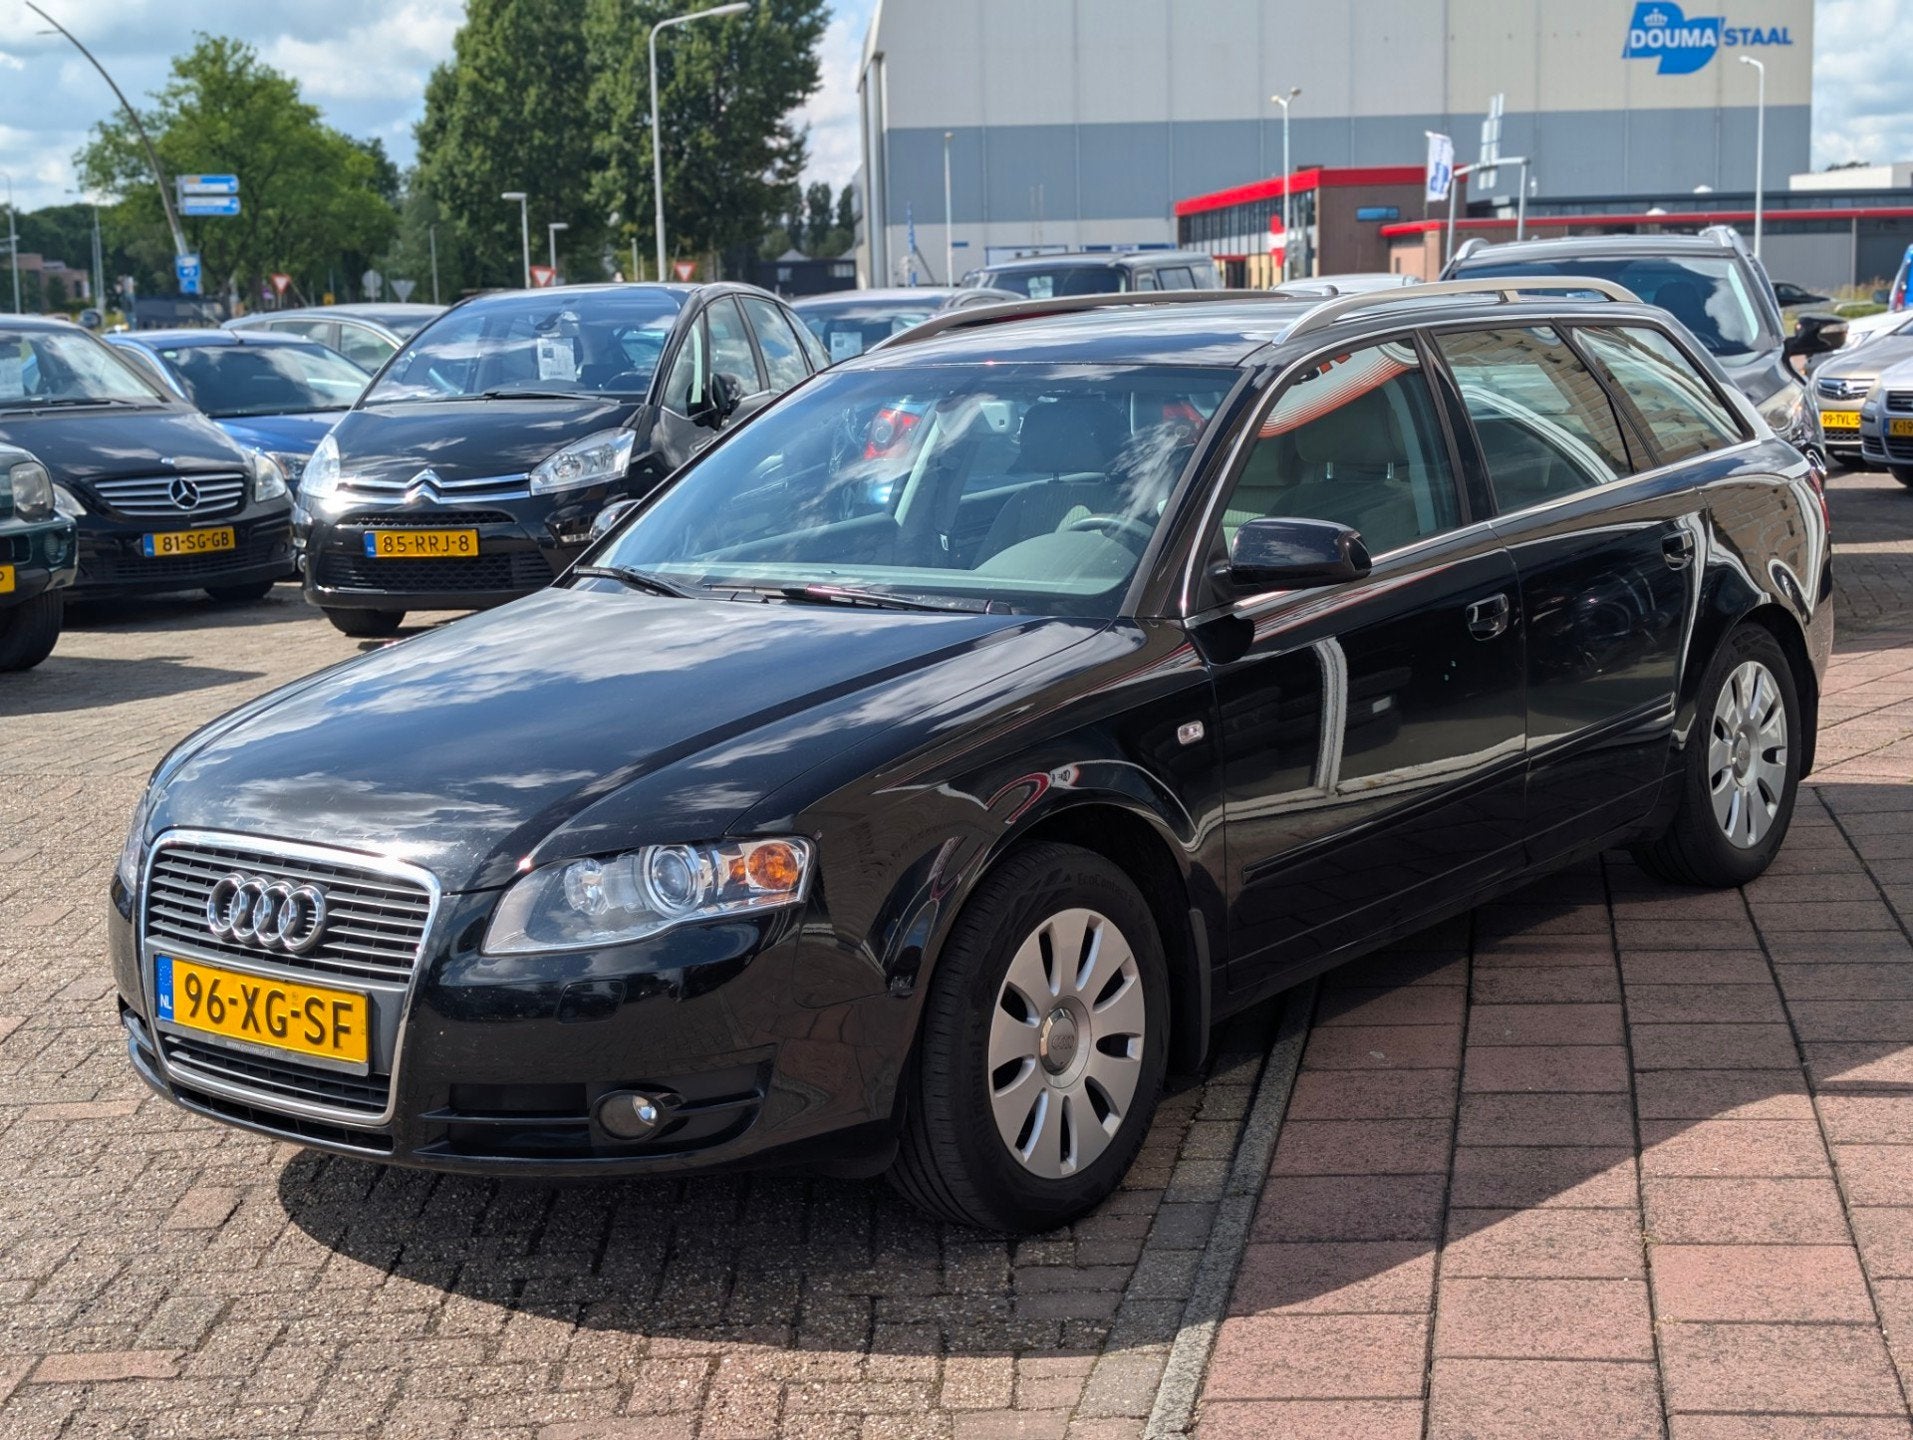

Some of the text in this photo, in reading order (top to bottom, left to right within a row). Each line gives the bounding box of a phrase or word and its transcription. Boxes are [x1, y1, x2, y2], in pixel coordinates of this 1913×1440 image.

[1631, 27, 1792, 48] DOUMA STAAL
[163, 531, 229, 552] 81-SG-GB
[383, 535, 469, 552] 85-RRJ-8
[160, 993, 172, 1009] NL
[185, 971, 352, 1048] 96-XG-SF
